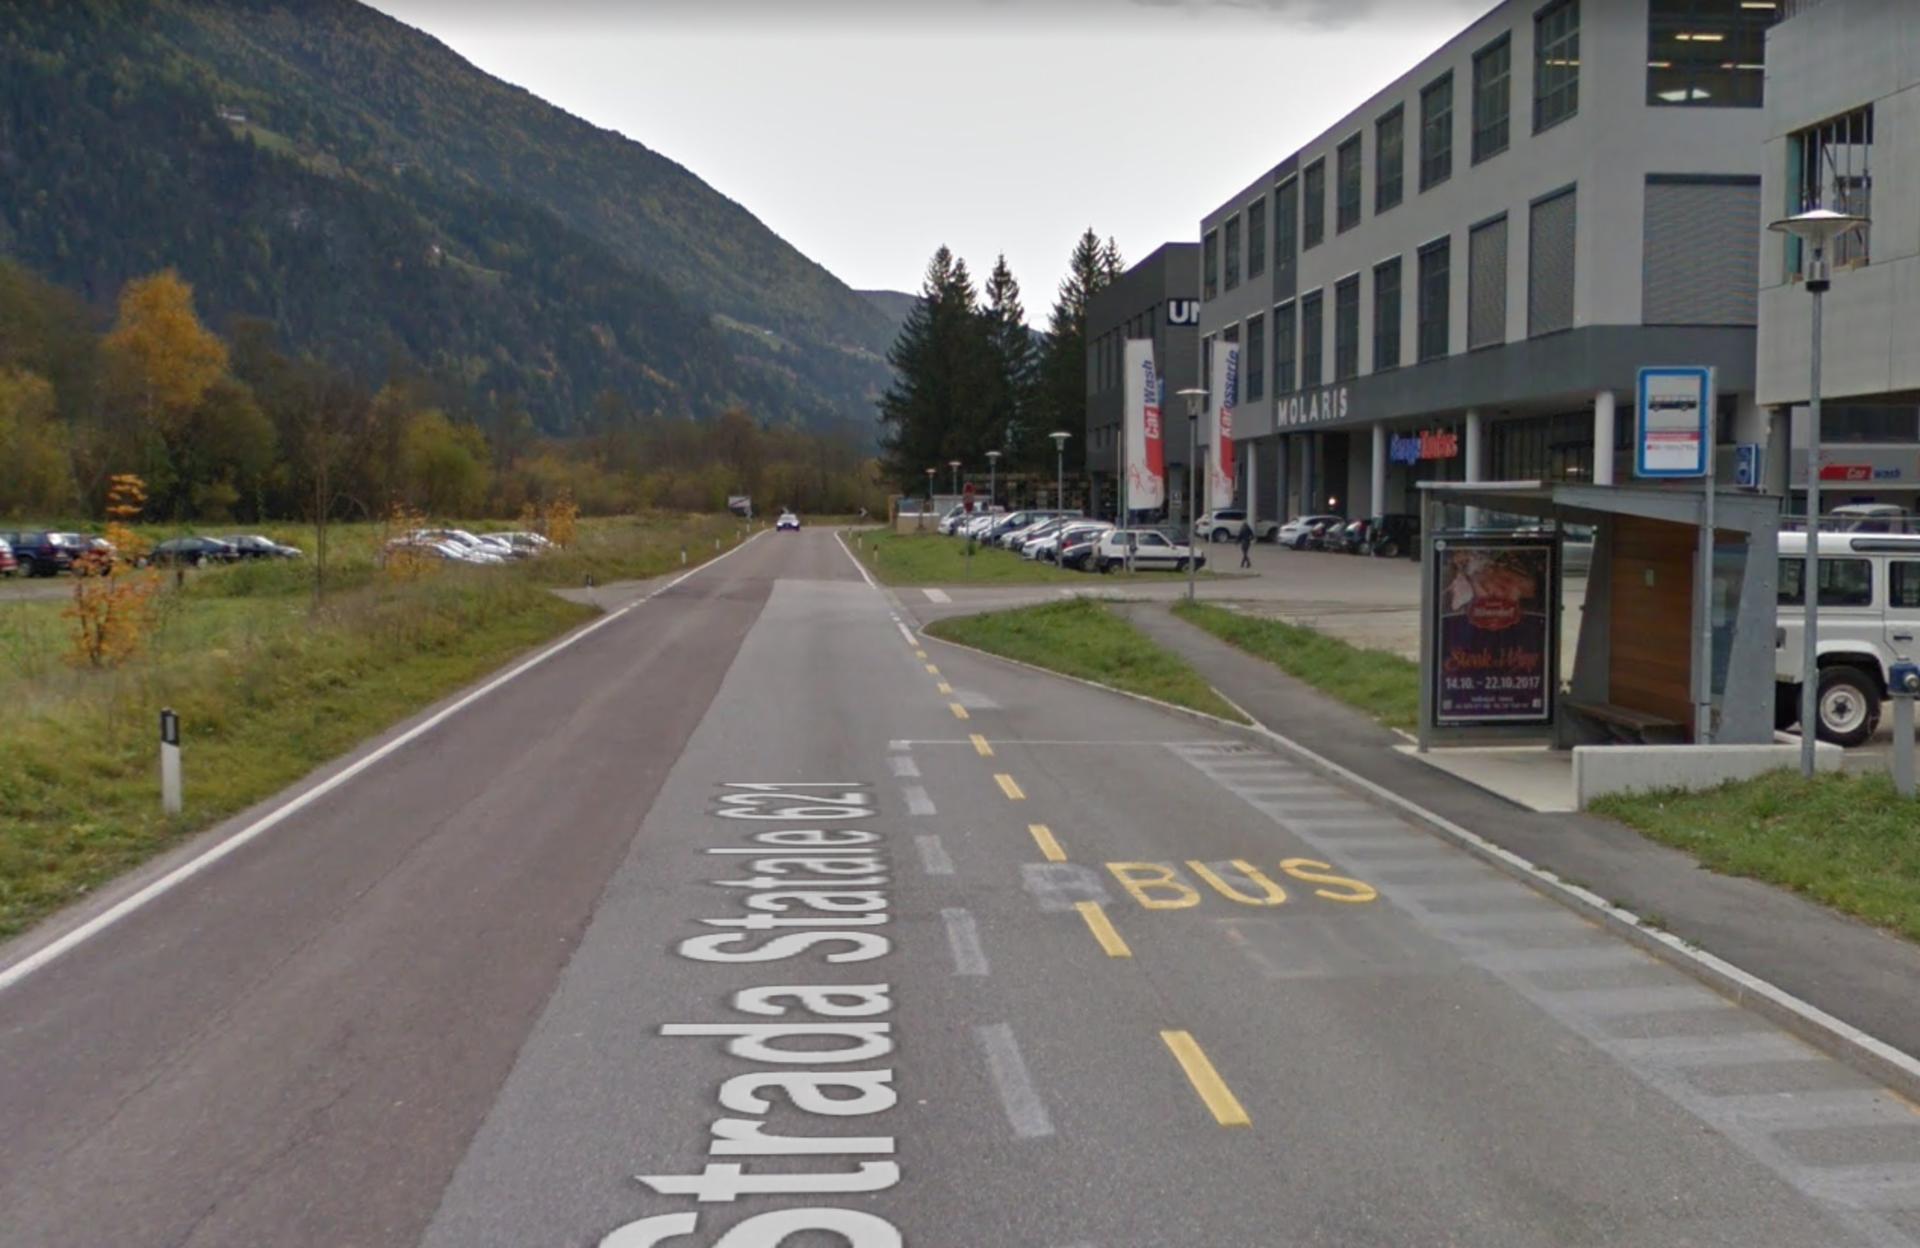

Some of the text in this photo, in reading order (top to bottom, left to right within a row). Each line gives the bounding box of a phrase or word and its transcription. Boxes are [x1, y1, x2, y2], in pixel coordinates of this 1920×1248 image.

[1141, 360, 1156, 403] Wash
[1221, 350, 1239, 437] Karosserie
[1277, 388, 1348, 427] MOLARIS
[1445, 677, 1474, 690] 14.10.
[1485, 676, 1541, 690] 22.10.2017
[1105, 857, 1377, 909] BUS
